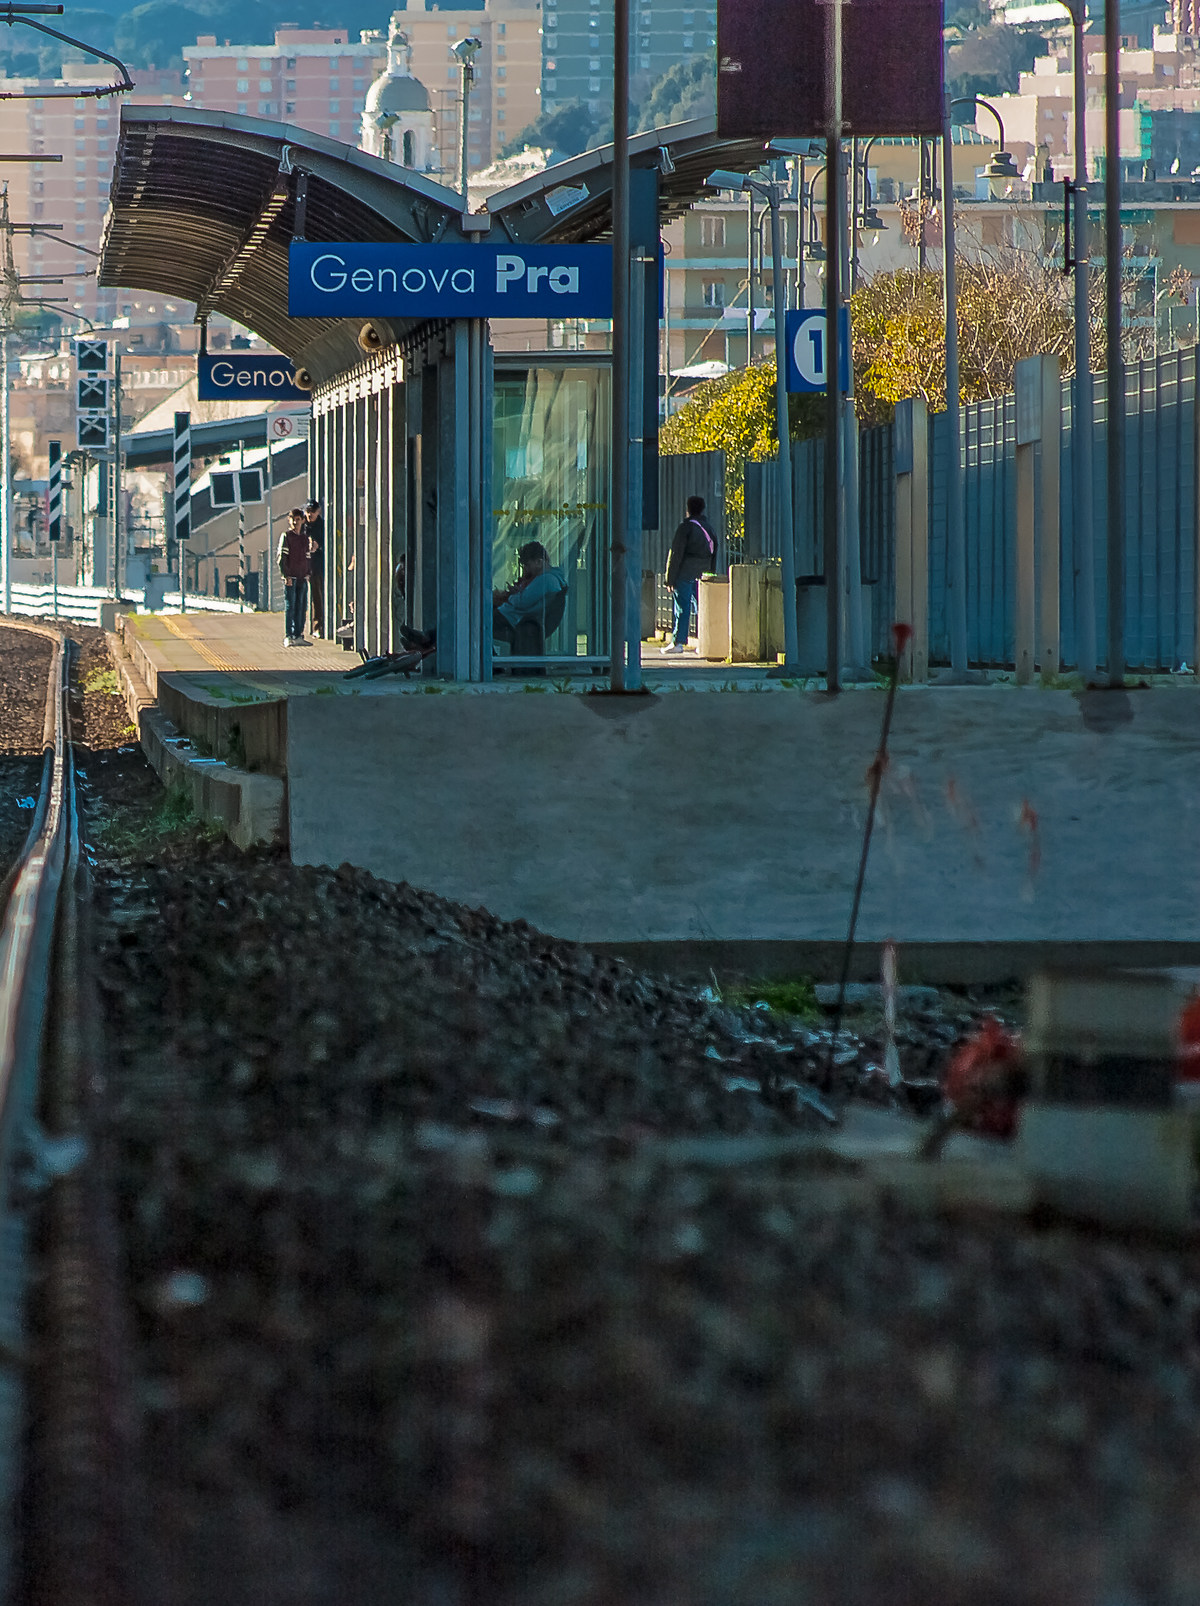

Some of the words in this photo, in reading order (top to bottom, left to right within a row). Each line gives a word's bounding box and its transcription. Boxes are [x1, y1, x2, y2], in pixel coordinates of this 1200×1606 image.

[311, 254, 475, 294] Genova
[496, 254, 580, 294] Pra
[808, 329, 823, 374] 1
